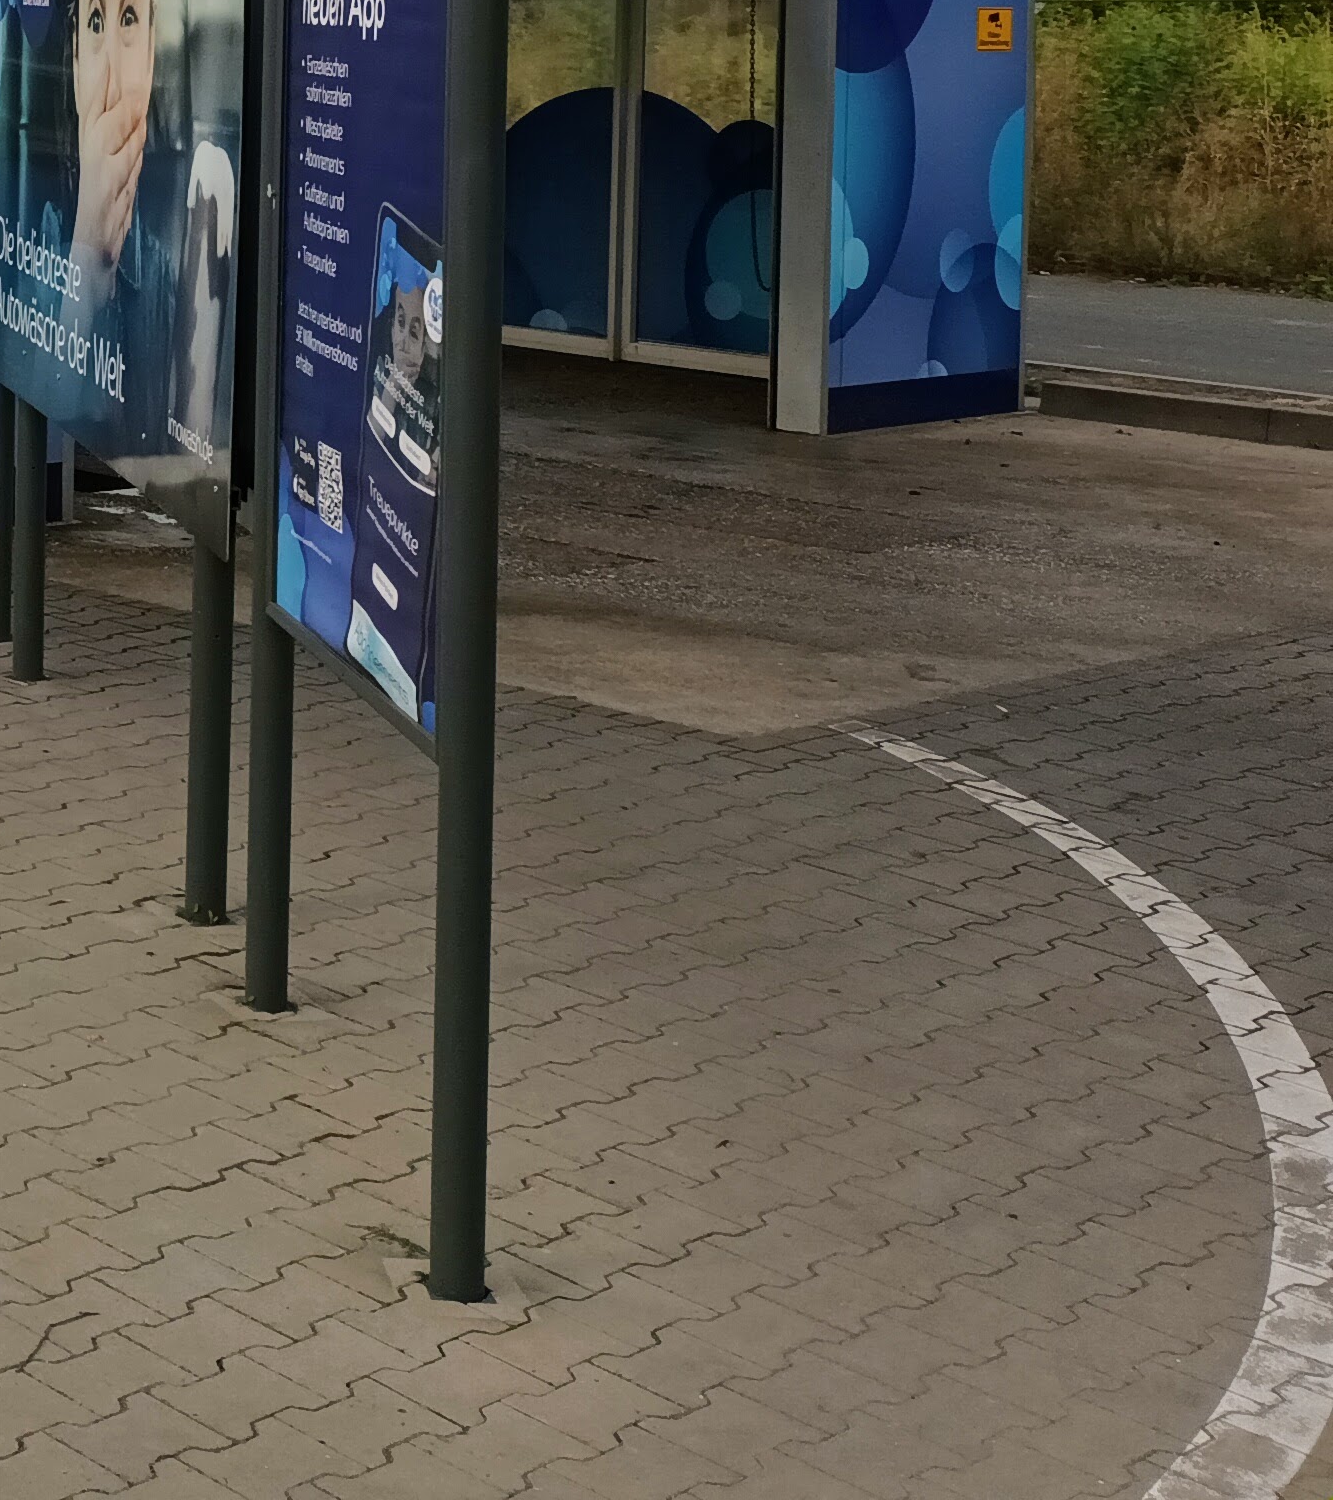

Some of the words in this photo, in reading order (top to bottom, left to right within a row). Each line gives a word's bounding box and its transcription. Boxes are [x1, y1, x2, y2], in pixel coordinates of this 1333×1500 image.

[305, 81, 321, 102] sofort
[322, 84, 352, 107] bezahlen
[329, 191, 345, 211] und
[16, 222, 81, 302] beliebteste
[67, 318, 91, 377] der
[93, 333, 126, 402] Welt
[167, 408, 214, 465] imowash.de
[368, 475, 420, 556] Treuepunkte
